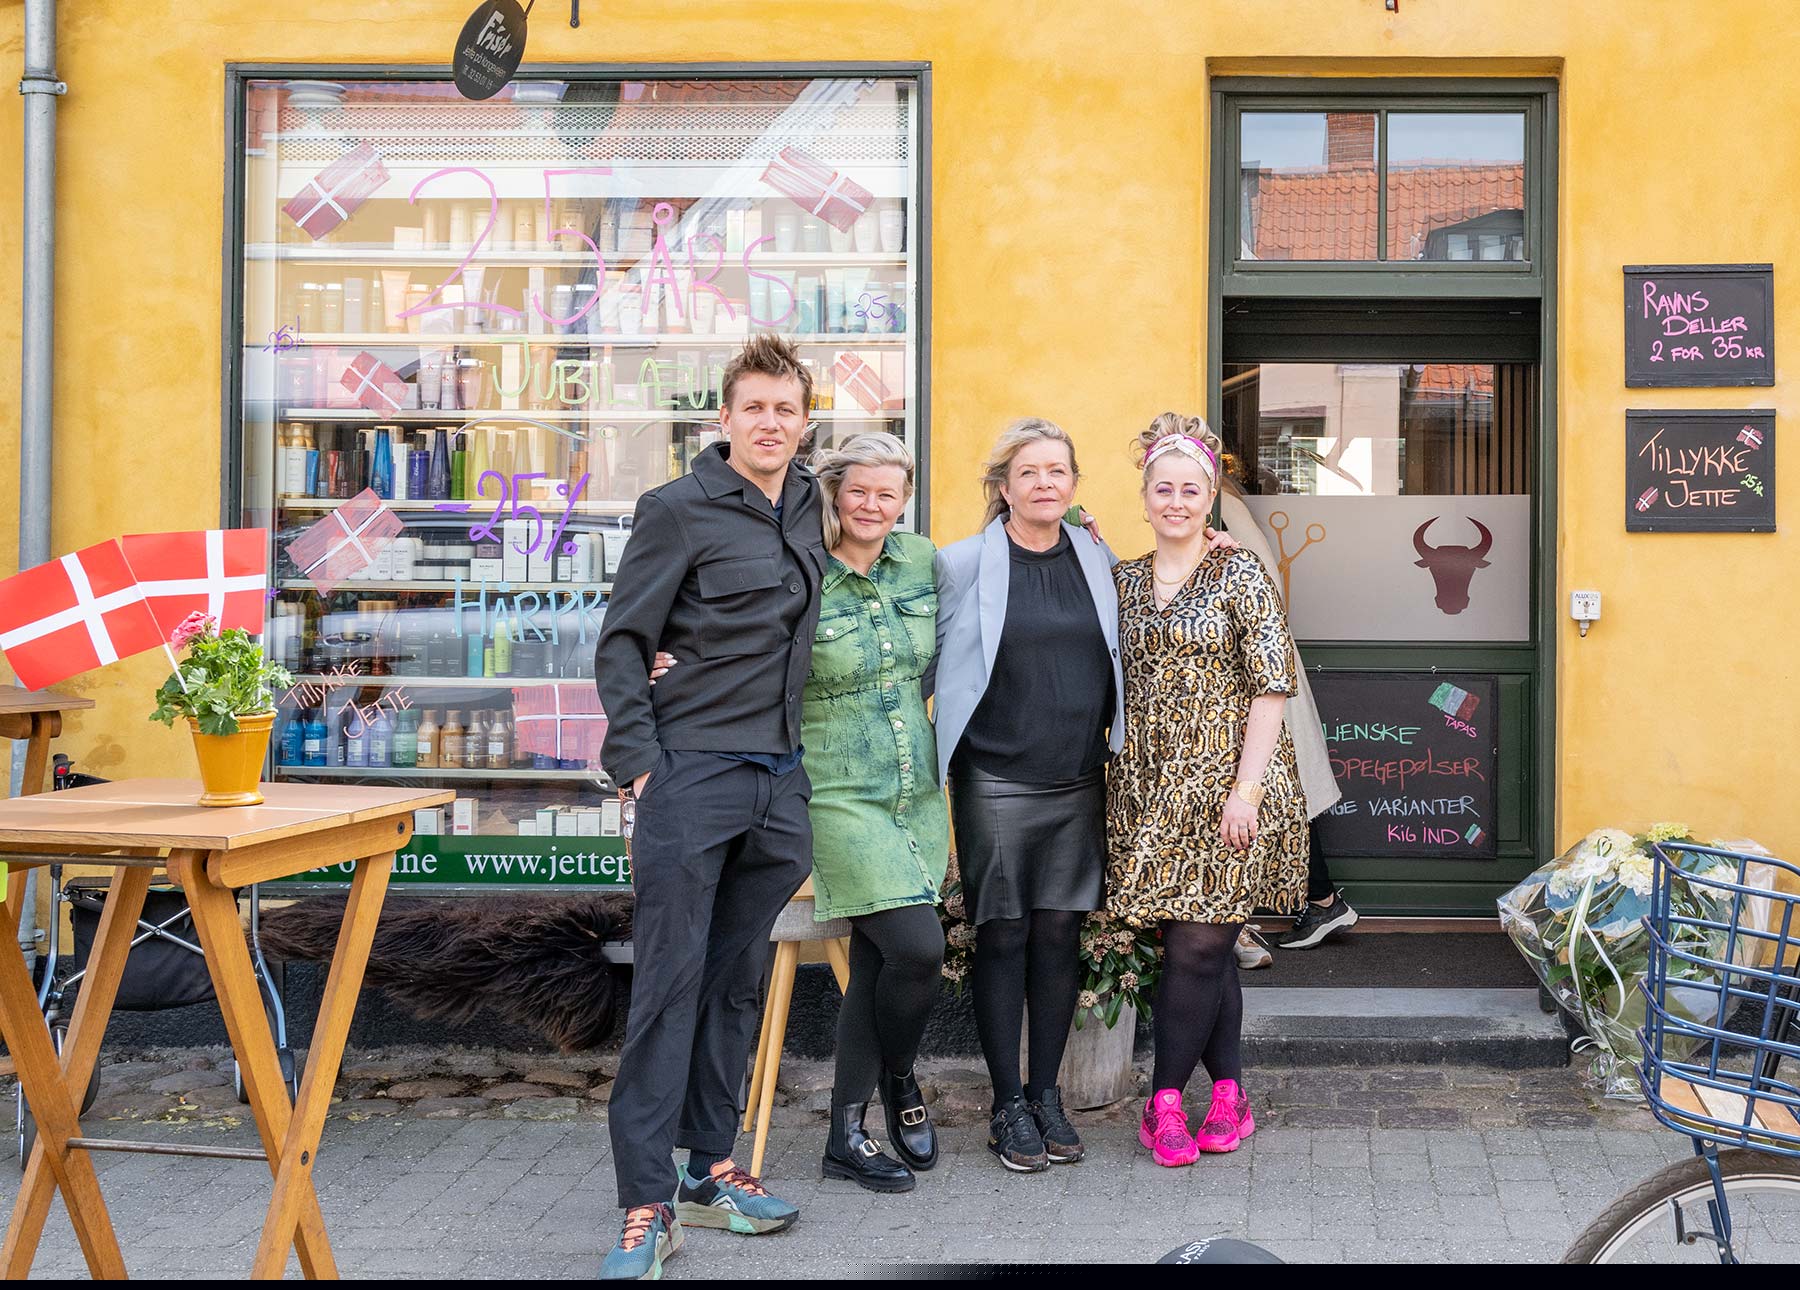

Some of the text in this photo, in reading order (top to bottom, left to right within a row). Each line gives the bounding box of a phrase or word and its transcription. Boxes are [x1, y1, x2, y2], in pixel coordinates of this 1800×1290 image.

[476, 10, 513, 58] Frisør
[397, 167, 797, 326] 25 ÅRS
[1642, 280, 1710, 319] RAVNS
[1662, 315, 1749, 336] DELLER
[1649, 336, 1765, 362] 2 FOR 35 KR
[1664, 479, 1742, 508] JETTE
[1740, 473, 1758, 488] 25
[433, 470, 591, 562] -25%
[337, 684, 414, 739] JETTE
[1444, 714, 1478, 738] TAPAS
